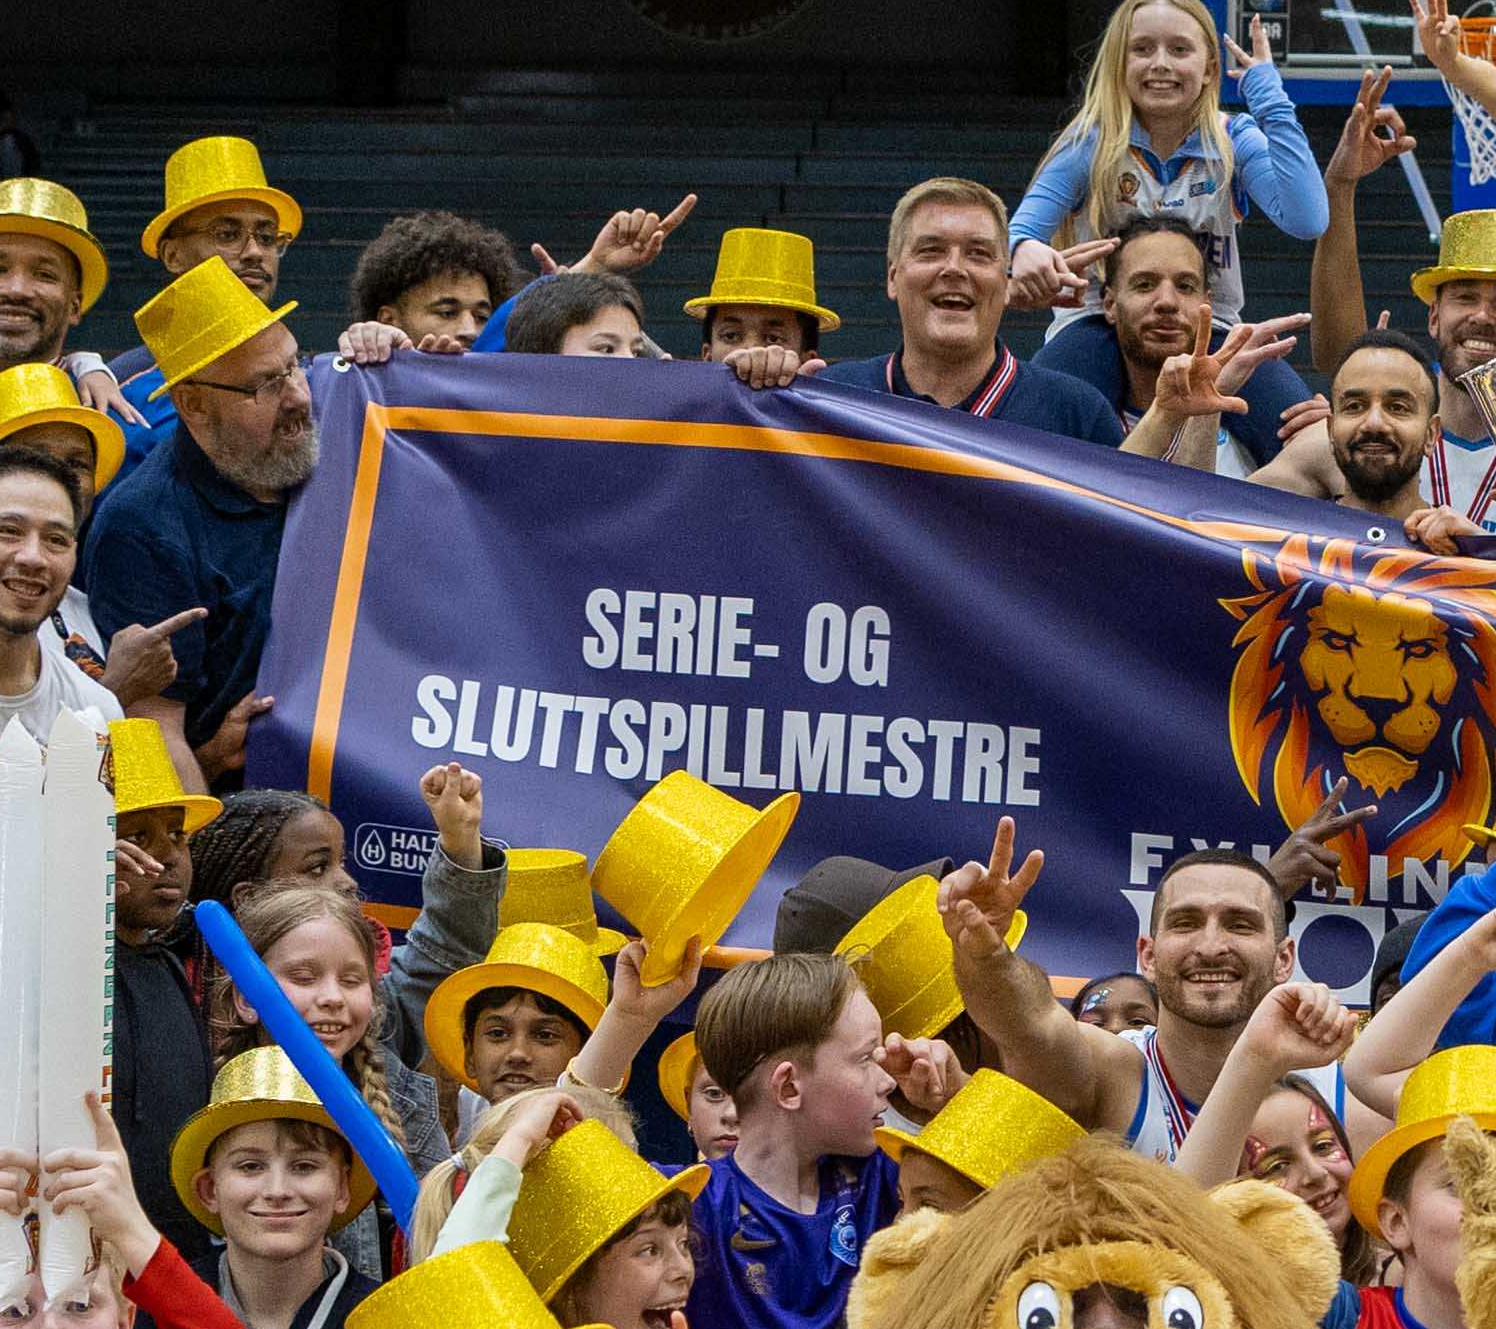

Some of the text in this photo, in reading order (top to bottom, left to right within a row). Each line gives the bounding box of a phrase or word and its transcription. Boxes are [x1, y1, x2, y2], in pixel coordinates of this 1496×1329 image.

[582, 588, 891, 687] SERIE- OG
[411, 674, 1042, 807] SLUTTSPILLMESTRE
